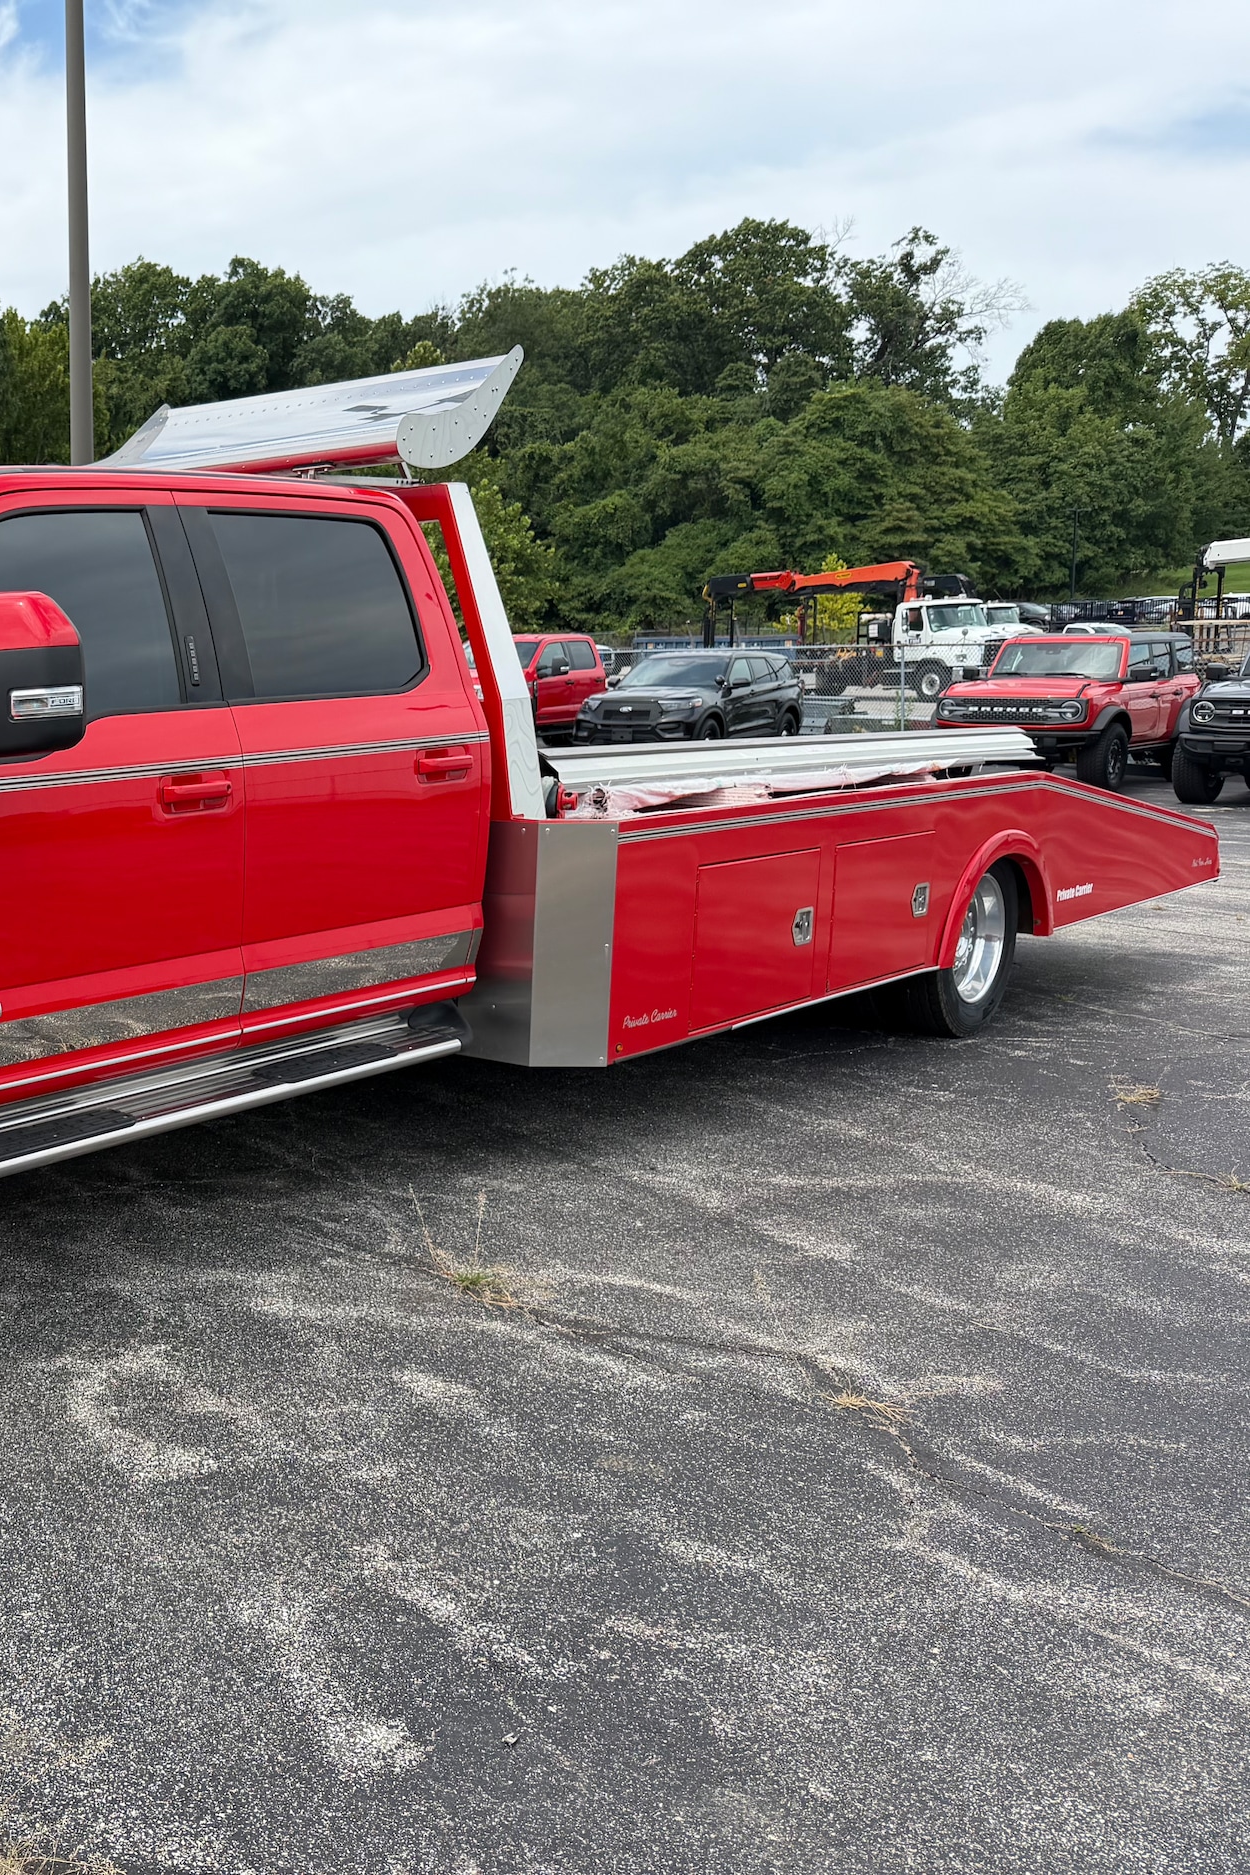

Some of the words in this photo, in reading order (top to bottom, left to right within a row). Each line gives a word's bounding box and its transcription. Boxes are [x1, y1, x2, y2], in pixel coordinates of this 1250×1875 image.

[1056, 888, 1075, 902] Private
[1075, 882, 1094, 898] Carrier
[622, 1015, 650, 1029] Private
[650, 1008, 678, 1023] Carrier
